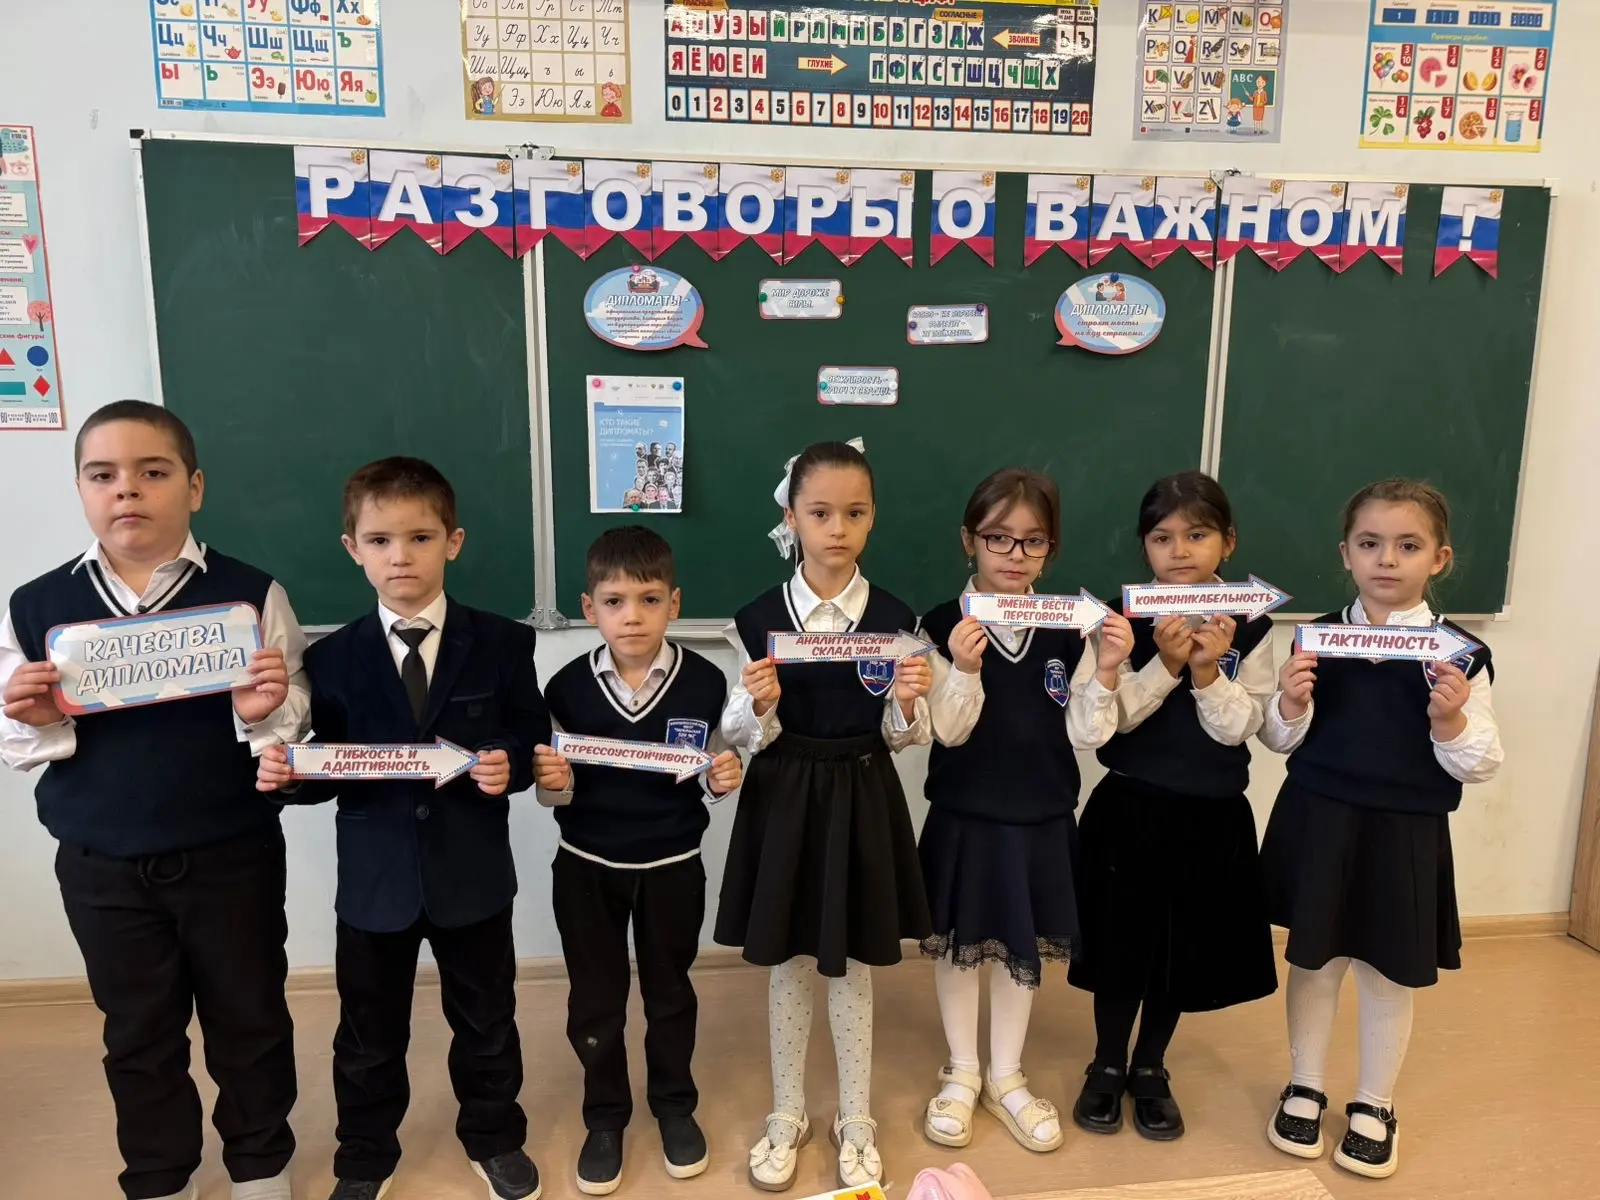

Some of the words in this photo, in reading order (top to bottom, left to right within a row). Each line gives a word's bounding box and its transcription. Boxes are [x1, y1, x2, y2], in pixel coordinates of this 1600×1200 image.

[1148, 9, 1158, 23] K
[1176, 10, 1184, 23] L
[1204, 11, 1219, 25] M
[1232, 11, 1243, 25] N
[158, 24, 184, 46] Цц
[203, 26, 226, 47] Чч
[248, 27, 282, 49] Шш
[293, 30, 329, 53] Щщ
[473, 25, 490, 48] Уу
[502, 23, 527, 48] Фф
[533, 24, 559, 44] Хх
[568, 25, 589, 48] Цц
[601, 26, 620, 46] Чч
[1008, 35, 1039, 45] ЗВОНКИЕ
[1146, 39, 1156, 53] P
[1175, 40, 1187, 56] Q
[1230, 41, 1239, 56] S
[1258, 42, 1267, 56] T
[470, 55, 498, 74] Шш
[500, 55, 530, 79] Щщ
[807, 59, 834, 69] ГЛУХИЕ
[251, 67, 275, 89] Ээ
[295, 69, 330, 91] Юю
[340, 71, 363, 92] Яя
[1145, 70, 1156, 84] U
[1173, 71, 1184, 84] V
[1201, 71, 1217, 85] W
[1232, 73, 1253, 83] ABC
[508, 88, 525, 106] Ээ
[535, 88, 563, 108] Юю
[569, 89, 592, 109] Яя
[672, 95, 681, 111] 0
[694, 96, 700, 112] 1
[714, 97, 723, 112] 2
[735, 98, 744, 113] 3
[755, 98, 764, 114] 4
[776, 99, 785, 115] 5
[796, 100, 805, 116] 6
[817, 101, 826, 116] 7
[837, 101, 846, 117] 8
[857, 102, 866, 118] 9
[873, 103, 889, 119] 10
[895, 104, 909, 120] 11
[915, 105, 930, 120] 12
[935, 105, 950, 121] 13
[955, 106, 970, 121] 14
[975, 106, 990, 122] 15
[995, 107, 1009, 122] 16
[1014, 108, 1029, 123] 17
[1033, 109, 1048, 124] 18
[1053, 109, 1068, 124] 19
[1072, 110, 1090, 126] 20
[1144, 100, 1154, 114] X
[1172, 101, 1182, 114] Y
[1198, 101, 1208, 115] Z
[308, 164, 913, 239] РАЗГОВОРЫ
[938, 186, 987, 240] О
[1035, 191, 1400, 248] ВАЖНОМ
[606, 295, 683, 308] ДИПЛОМАТЫ
[1070, 304, 1148, 316] ДИПЛОМАТЫ
[997, 598, 1039, 610] УМЕНИЕ
[1042, 600, 1075, 611] ВЕСТИ
[1135, 593, 1273, 605] КОММУНИКАБЕЛЬНОСТЬ
[1003, 610, 1073, 622] ПЕРЕГОВОРЫ
[84, 622, 225, 663] КАЧЕСТВА
[1318, 633, 1440, 651] ТАКТИЧНОСТЬ
[812, 646, 853, 657] СКЛАД
[855, 646, 881, 655] УМА
[76, 647, 246, 697] ДИПЛОМАТА
[335, 749, 404, 760] ГИБКОСТЬ
[407, 750, 418, 759] И
[321, 760, 430, 774] АДАПТИВНОСТЬ
